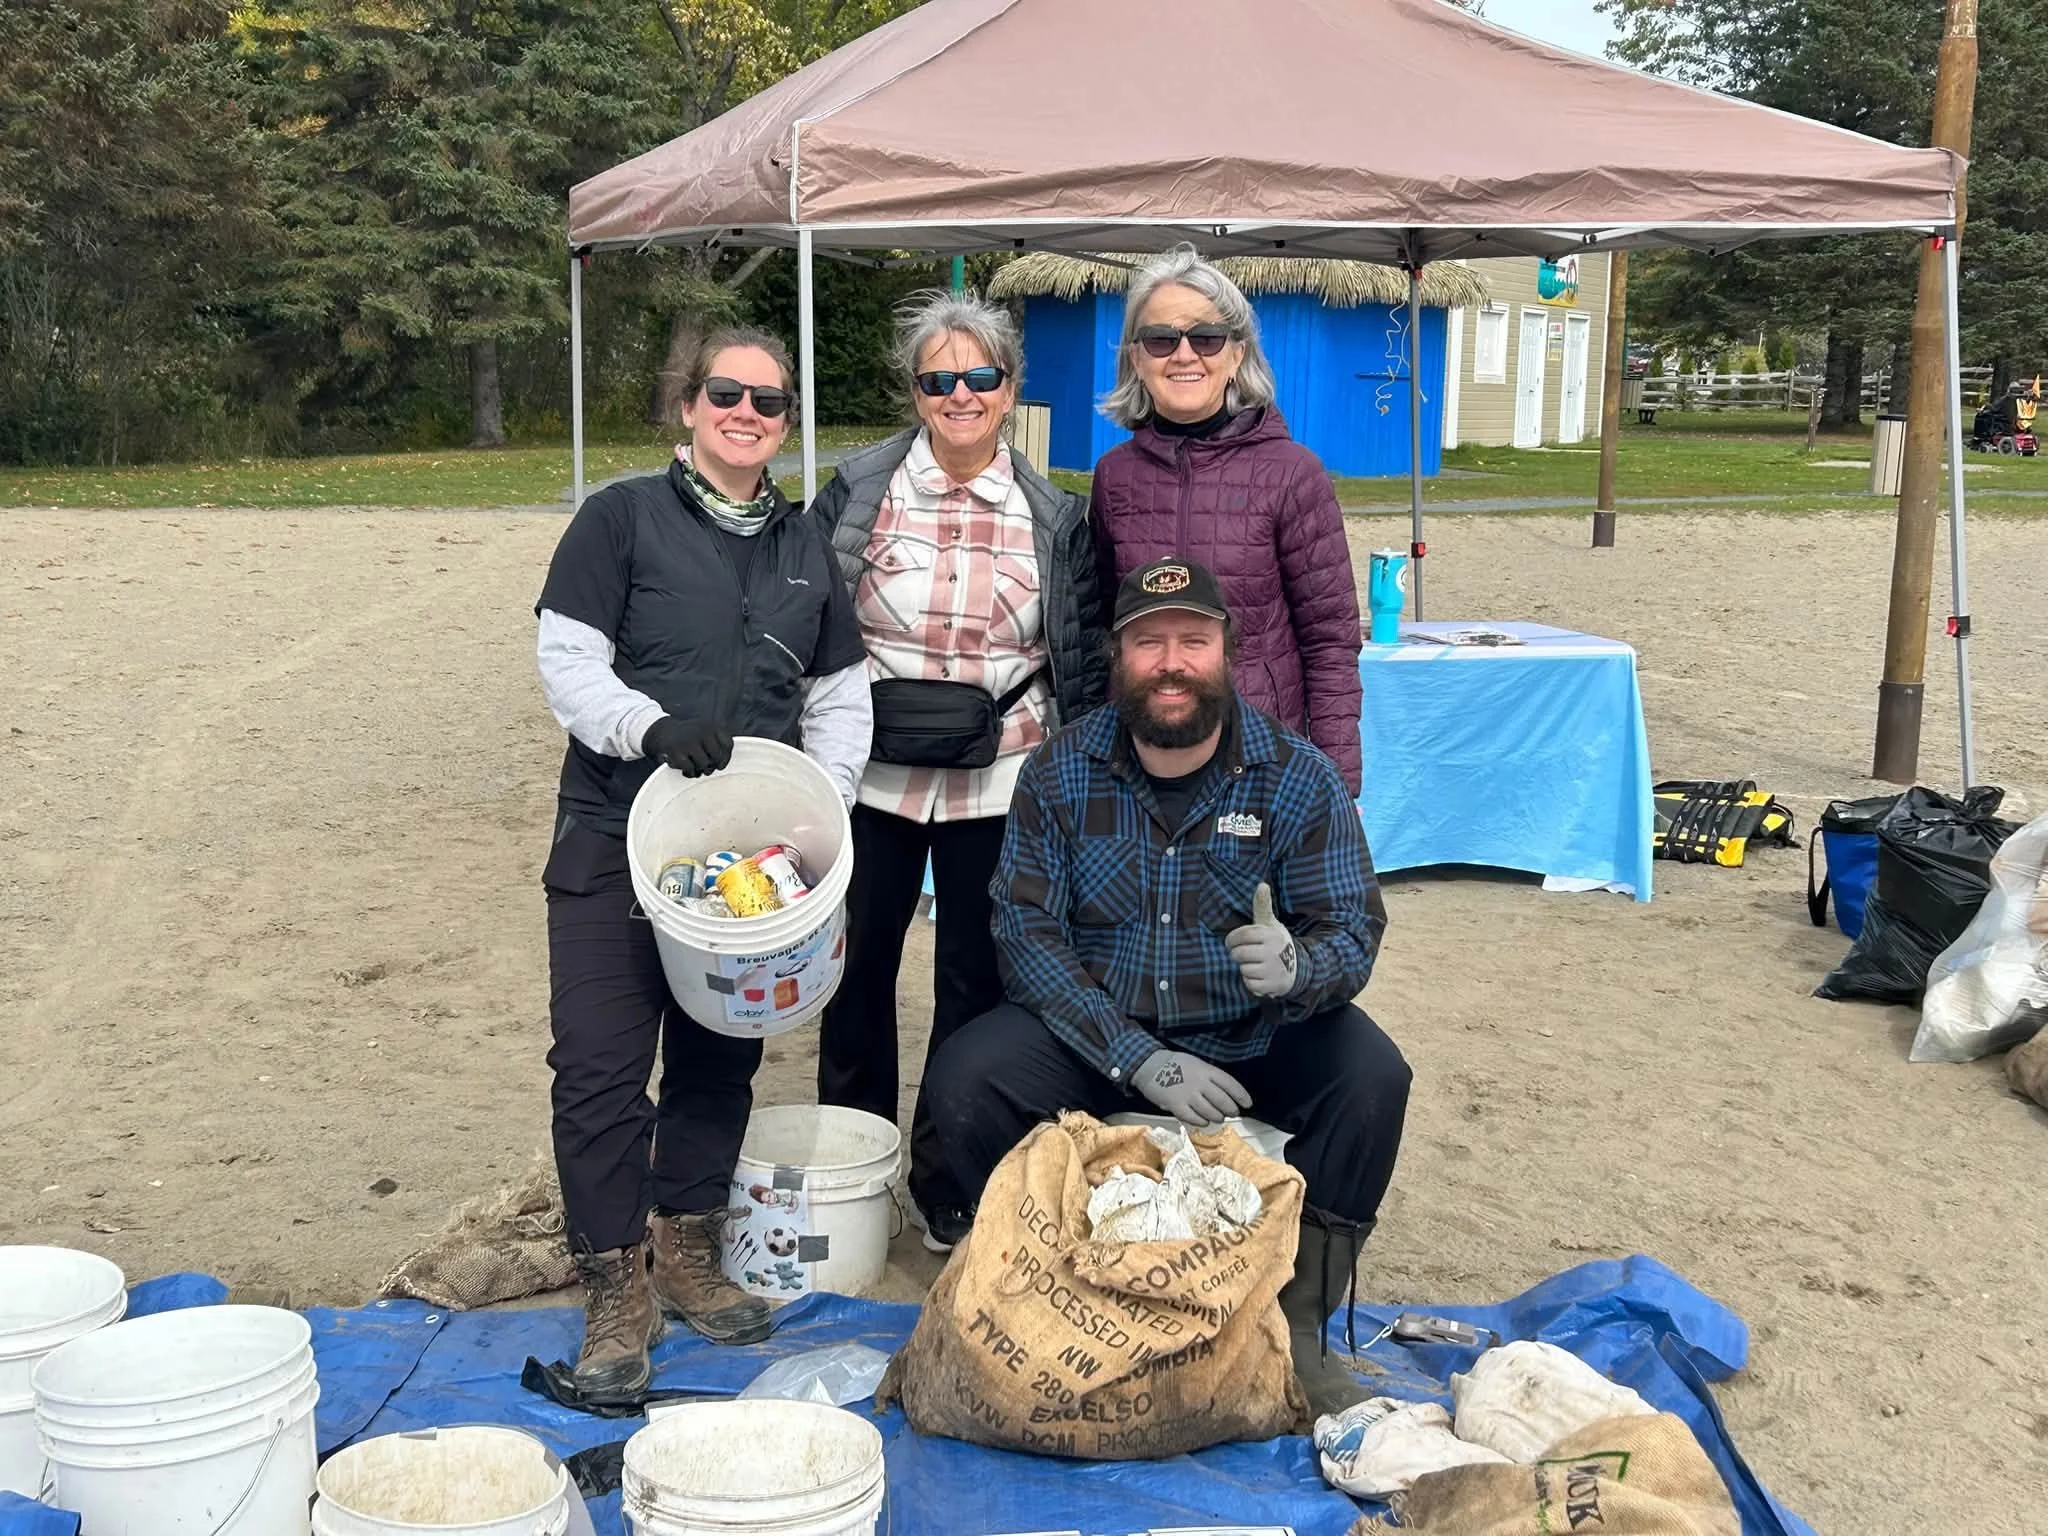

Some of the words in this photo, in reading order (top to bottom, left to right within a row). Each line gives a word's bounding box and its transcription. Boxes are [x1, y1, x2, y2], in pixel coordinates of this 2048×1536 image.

[736, 940, 806, 965] Breuvages
[1011, 1245, 1130, 1349] PROCESSED
[967, 1307, 1030, 1375] TYPE
[1030, 1370, 1075, 1405] 280
[1056, 1344, 1103, 1380] NW
[1029, 1391, 1153, 1424] EXCELSO
